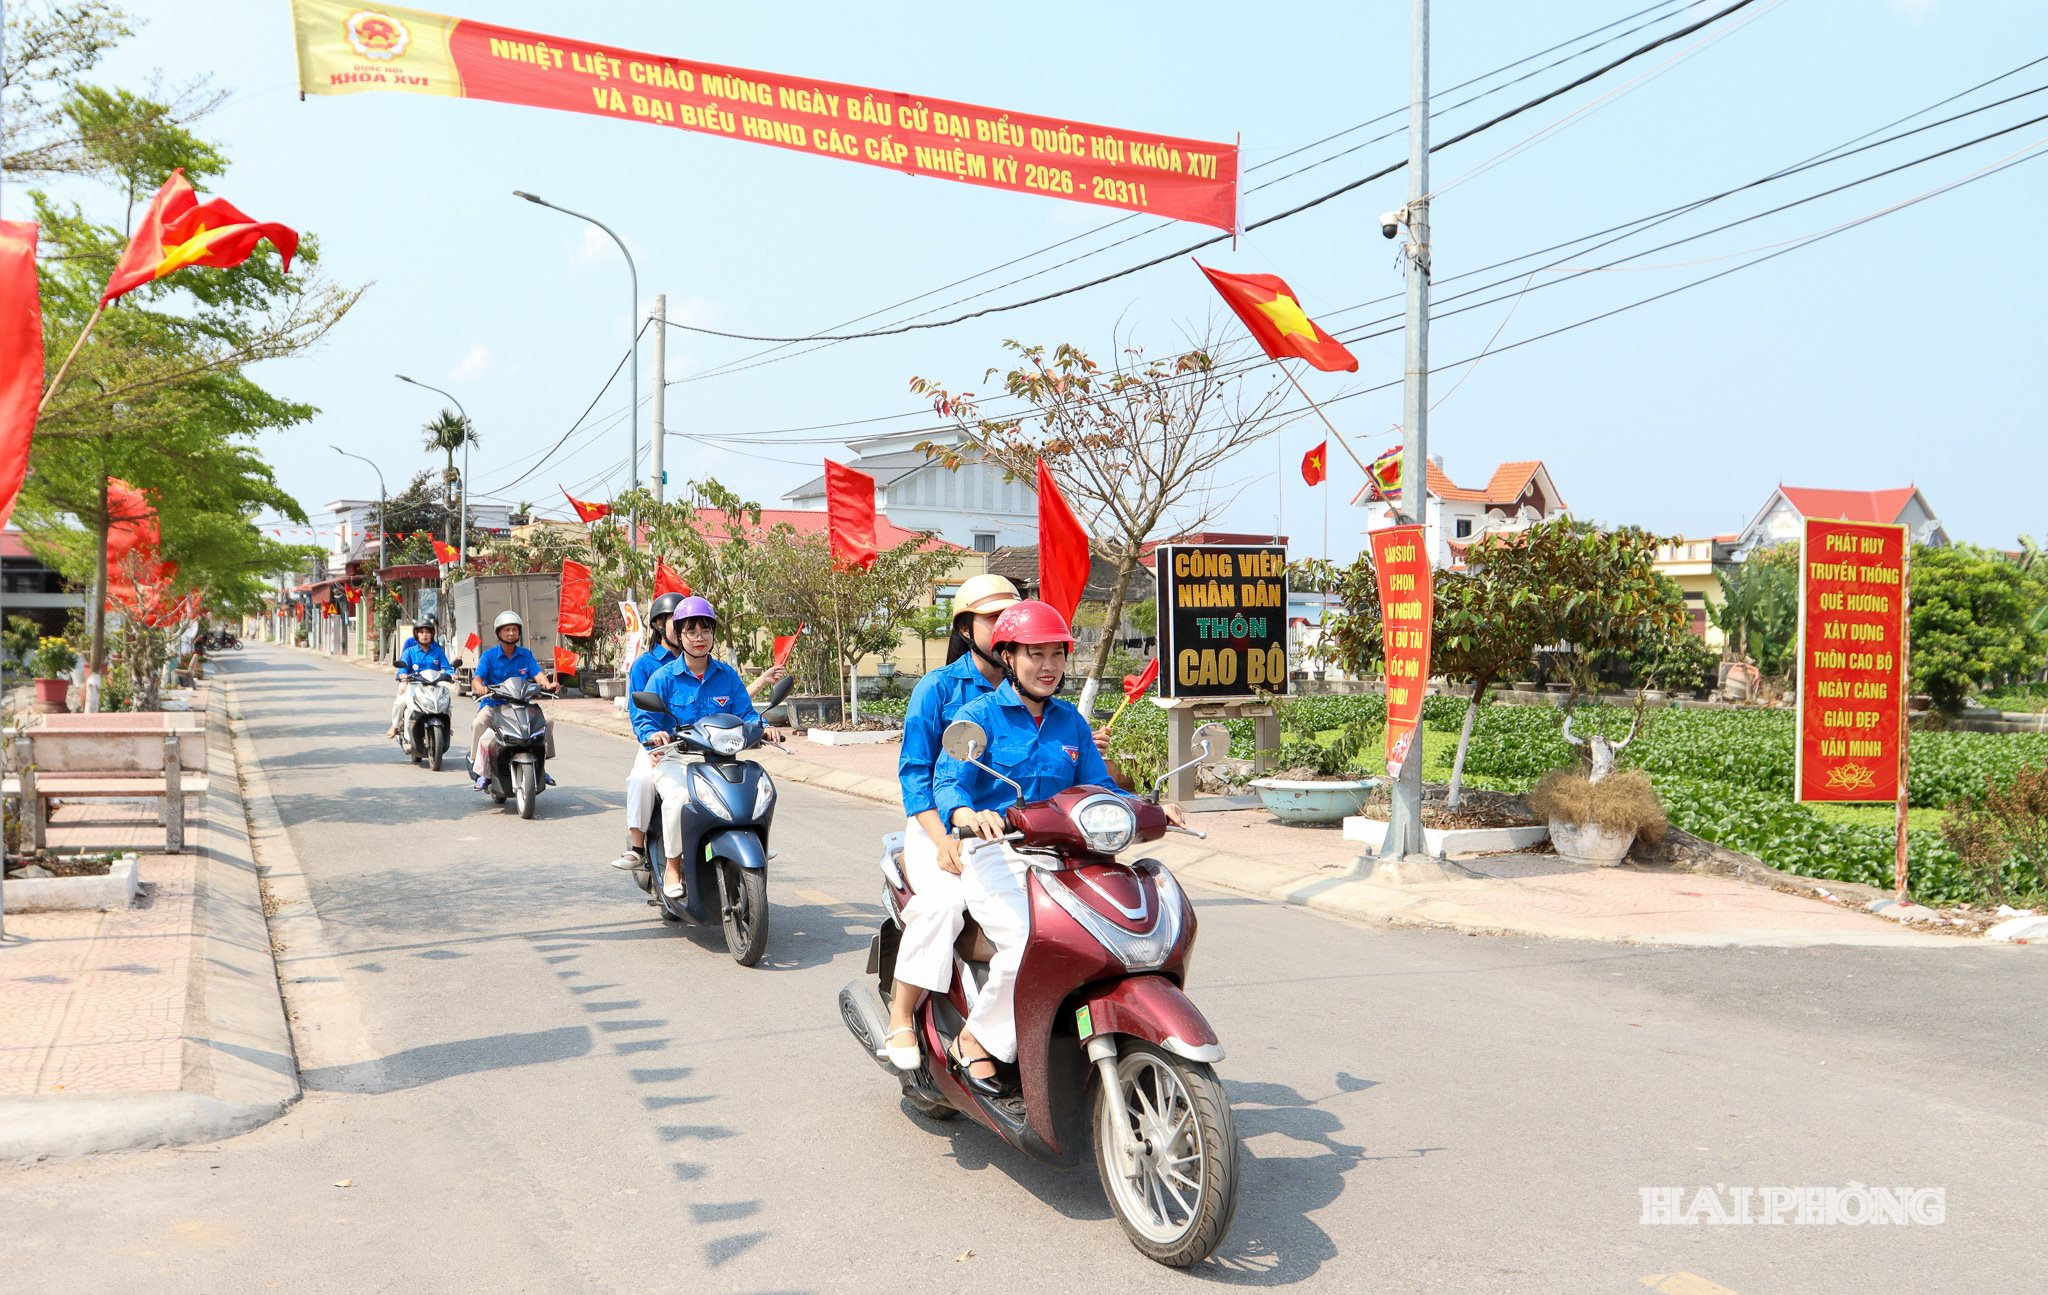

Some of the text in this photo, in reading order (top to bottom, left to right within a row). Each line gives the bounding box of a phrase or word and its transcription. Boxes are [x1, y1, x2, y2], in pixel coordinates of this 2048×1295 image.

[393, 75, 429, 86] XVI
[490, 38, 1217, 180] NHIỆT LIỆT CHÀO MỪNG NGÀY BẦU CỬ ĐẠI BIỂU QUỐC HỘI KHÓA XVI
[592, 86, 627, 113] VÀ
[632, 94, 675, 124] ĐẠI
[680, 103, 736, 133] BIỂU
[742, 115, 807, 147] HĐND
[813, 128, 859, 157] CÁC
[864, 134, 909, 164] CẤP
[915, 146, 987, 181] NHIỆM
[992, 155, 1018, 185] KỲ
[1025, 163, 1074, 194] 2026
[1092, 175, 1148, 206] 2031!
[1826, 533, 1884, 554] PHÁT HUY
[1175, 549, 1284, 578] CÔNG VIÊN
[1810, 560, 1899, 584] TRUYỀN THỐNG
[1178, 579, 1281, 608] NHÂN DÂN
[1820, 590, 1888, 612] QUÊ HƯƠNG
[1395, 599, 1422, 620] NGƯỜI
[1196, 612, 1267, 639] THÔN
[1824, 620, 1884, 644] XÂY DỰNG
[1410, 628, 1423, 649] TÀI
[1178, 641, 1285, 691] CAO BỘ
[1405, 656, 1420, 682] HỘI
[1814, 649, 1893, 674] THÔN CAO BỘ
[1818, 678, 1887, 699] NGÀY CÀNG
[1824, 708, 1880, 732] GIÀU ĐẸP
[1821, 737, 1882, 757] VĂN MINH
